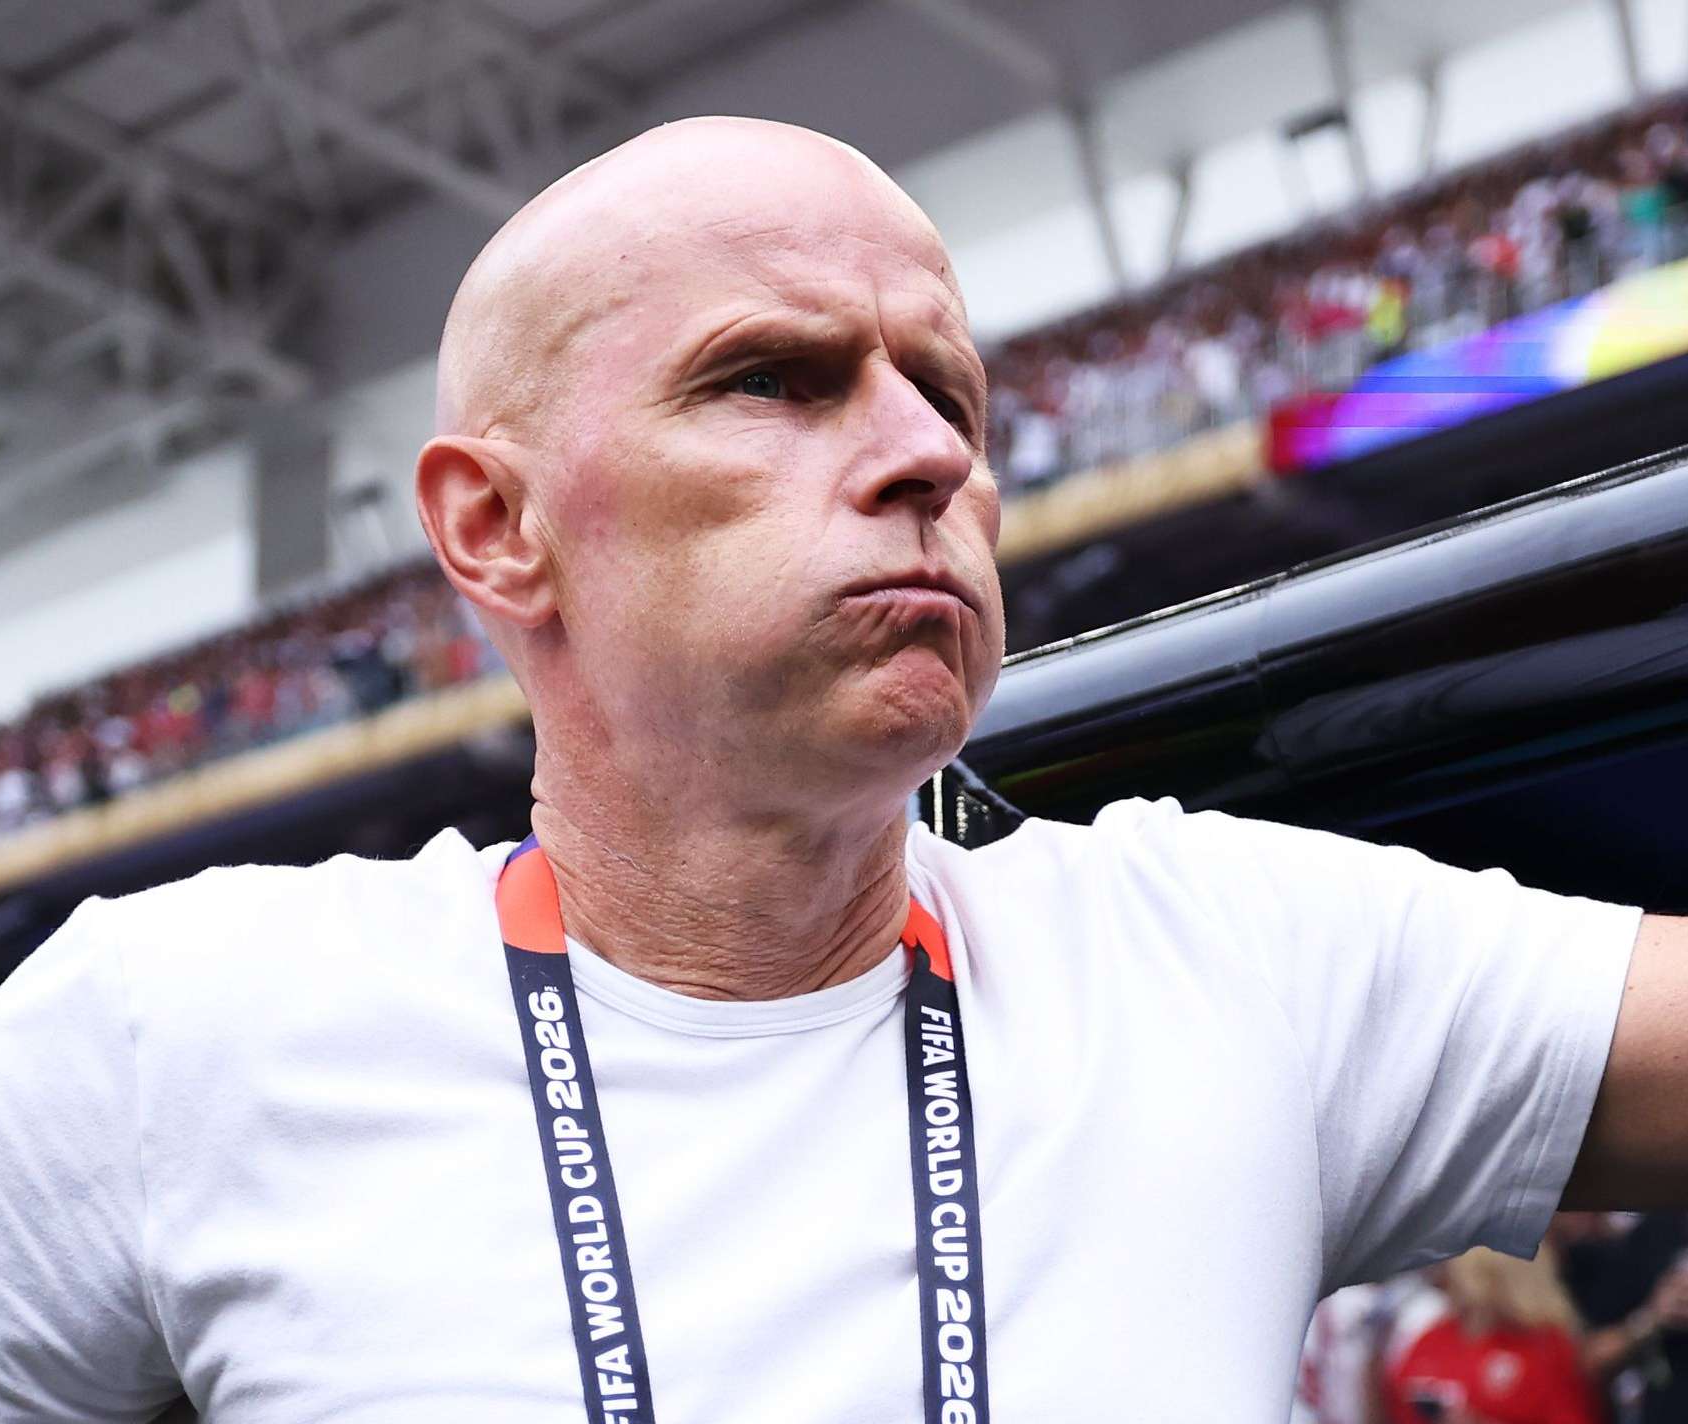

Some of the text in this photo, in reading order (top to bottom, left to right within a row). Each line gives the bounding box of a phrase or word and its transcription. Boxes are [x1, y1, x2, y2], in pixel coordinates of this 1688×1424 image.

[921, 1004, 955, 1067] FIFA
[554, 1119, 598, 1190] CUP
[923, 1069, 963, 1197] WORLD
[565, 1195, 622, 1341] WORLD
[928, 1200, 968, 1282] CUP
